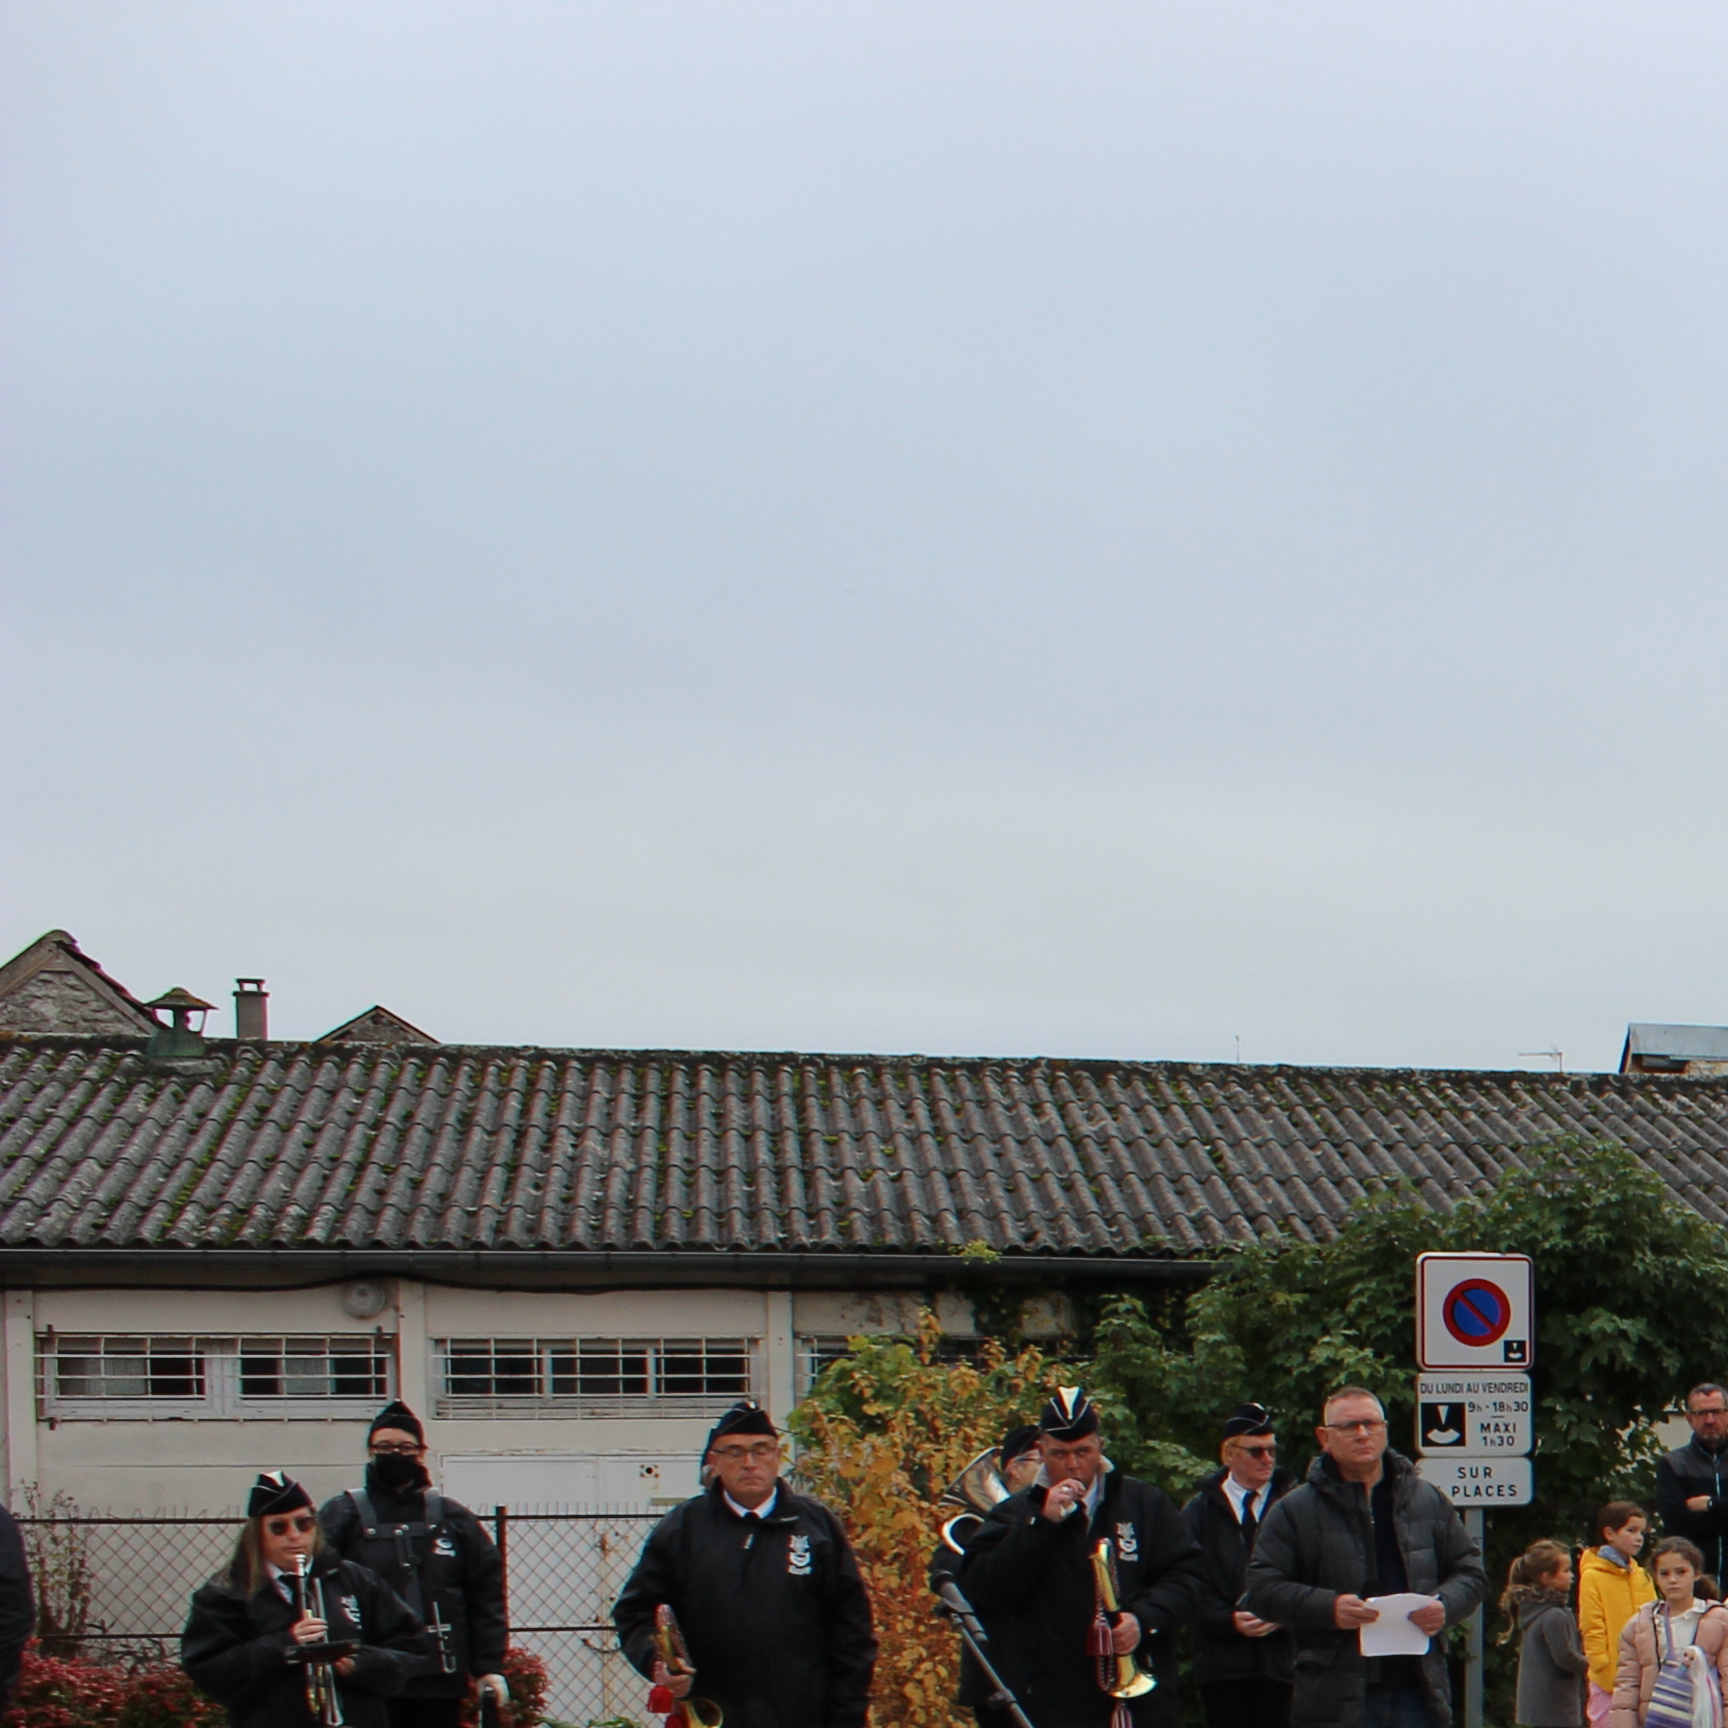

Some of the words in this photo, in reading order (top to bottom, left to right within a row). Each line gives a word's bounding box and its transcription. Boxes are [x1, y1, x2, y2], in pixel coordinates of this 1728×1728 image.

[1420, 1382, 1434, 1394] DU
[1436, 1382, 1464, 1394] LUNDI
[1466, 1382, 1480, 1394] AU
[1481, 1382, 1529, 1394] VENDREDI
[1480, 1422, 1517, 1434] MAXI
[1482, 1435, 1515, 1447] 1h30
[1457, 1466, 1492, 1479] SUR
[1451, 1484, 1517, 1497] PLACES
